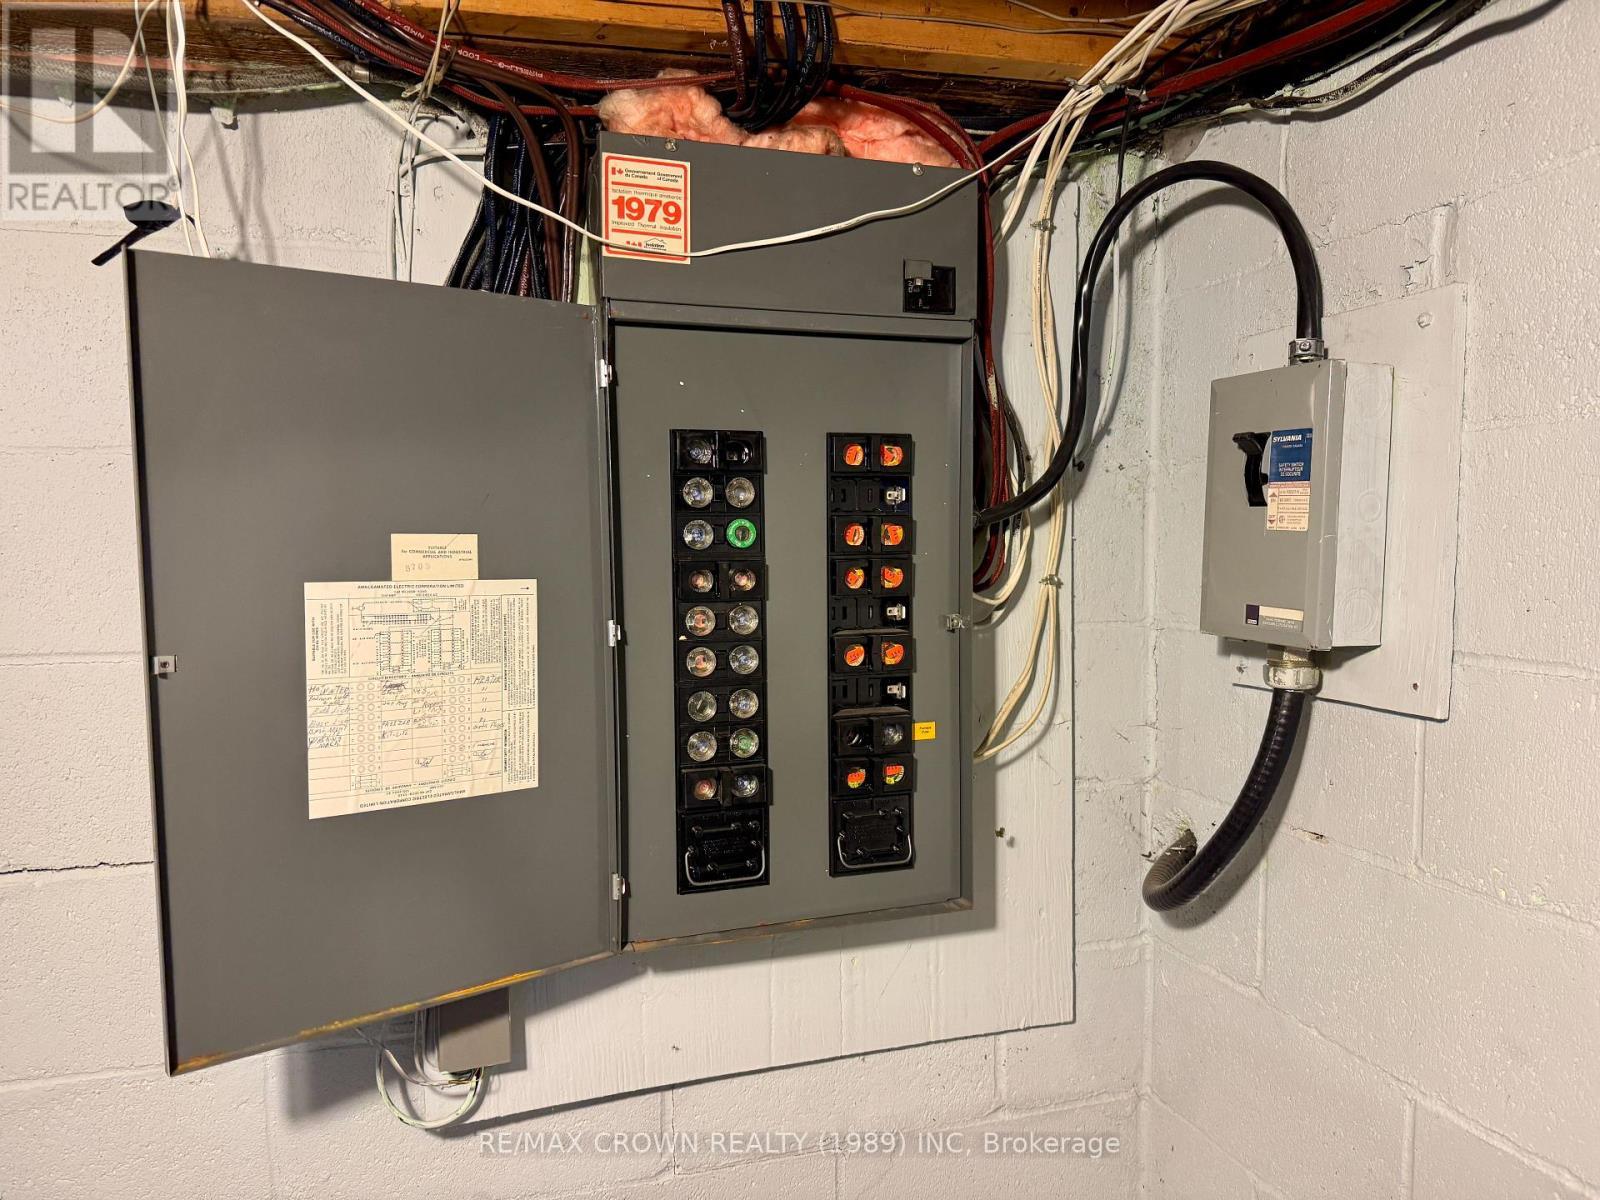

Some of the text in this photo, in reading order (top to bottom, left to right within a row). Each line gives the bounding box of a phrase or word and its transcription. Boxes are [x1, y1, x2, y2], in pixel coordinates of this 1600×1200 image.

[656, 171, 682, 179] Government
[612, 196, 682, 225] 1979
[1272, 434, 1302, 442] SYLVANIA
